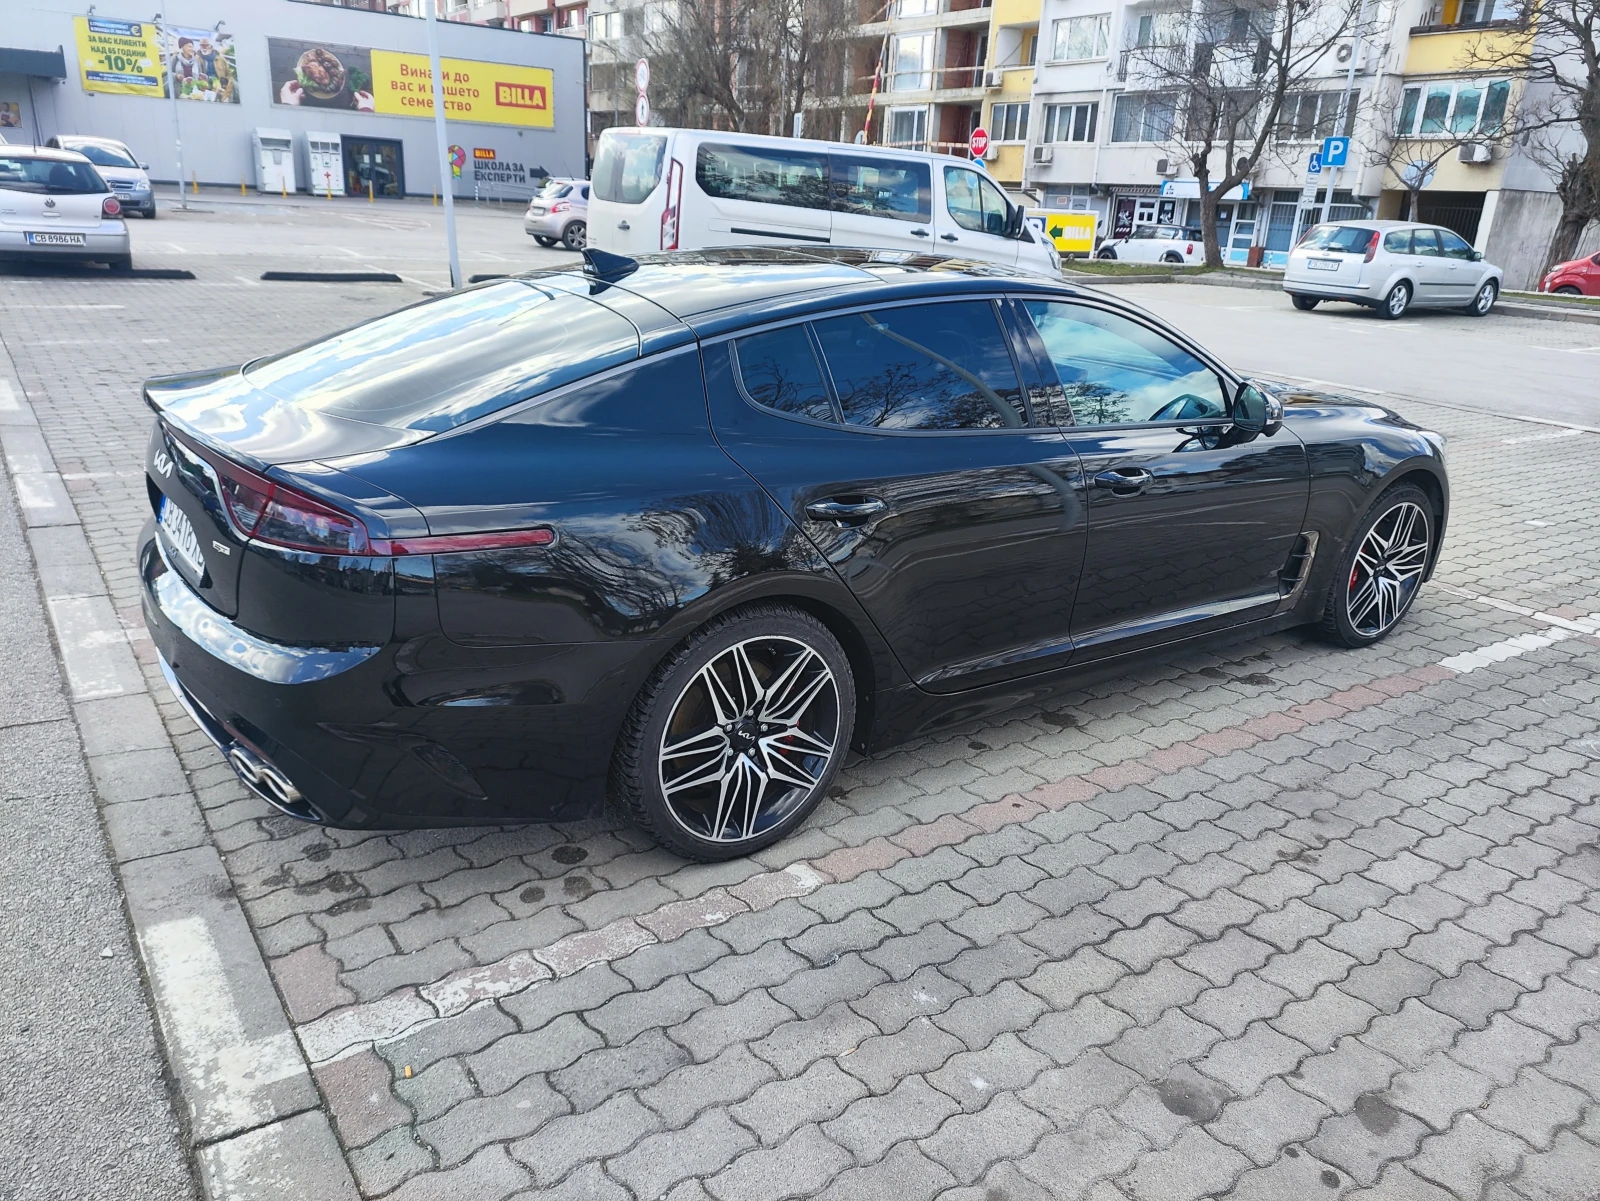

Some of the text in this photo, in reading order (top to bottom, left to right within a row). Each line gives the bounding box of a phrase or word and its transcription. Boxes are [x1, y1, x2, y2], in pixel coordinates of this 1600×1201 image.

[98, 36, 113, 44] ВАС
[113, 38, 147, 48] КЛИЕНТИ
[90, 45, 107, 55] НАД
[117, 48, 147, 58] ГОДИНИ
[98, 55, 143, 73] -10%
[400, 63, 470, 84] Винаи до
[390, 80, 414, 92] вас
[418, 83, 426, 93] и
[498, 85, 544, 107] BILLA
[400, 96, 472, 112] семество
[972, 136, 987, 149] STOP
[474, 149, 495, 158] BILLA
[1327, 140, 1344, 163] P
[473, 160, 525, 172] ШКОЛА ЗА
[473, 170, 526, 184] ЕКСПЕРТИ
[34, 234, 47, 243] CB
[1063, 225, 1091, 240] BILLA
